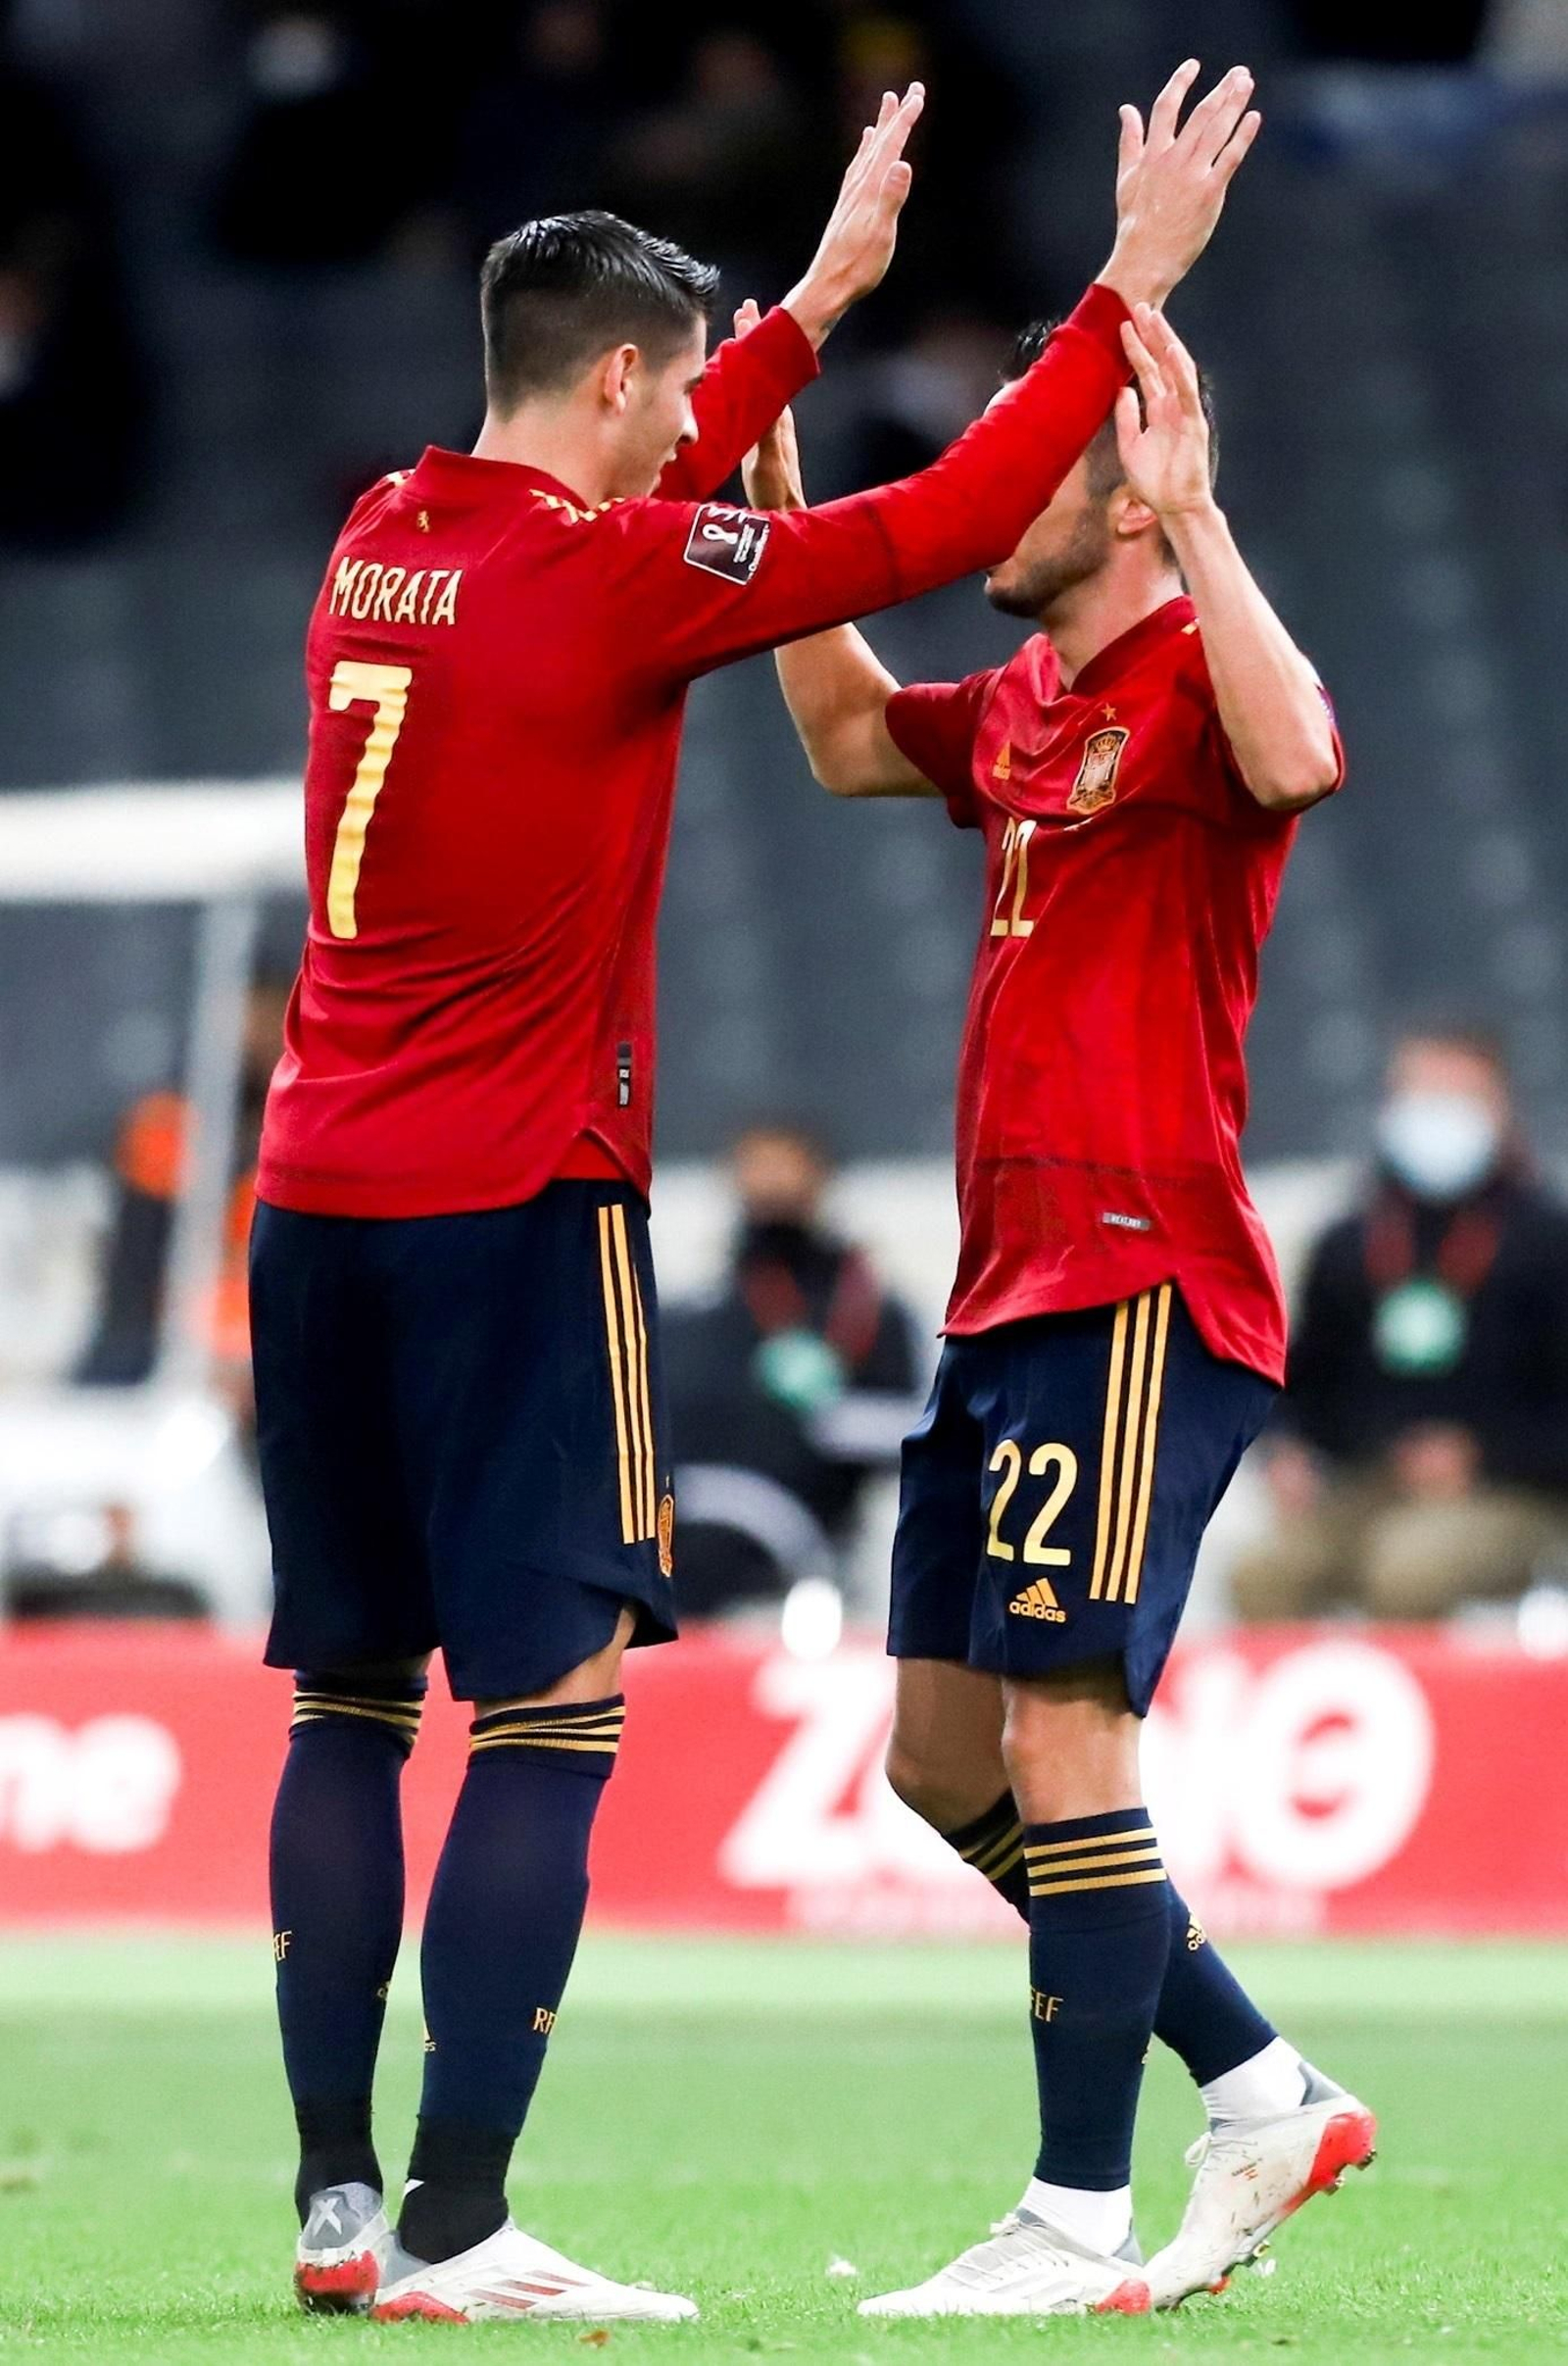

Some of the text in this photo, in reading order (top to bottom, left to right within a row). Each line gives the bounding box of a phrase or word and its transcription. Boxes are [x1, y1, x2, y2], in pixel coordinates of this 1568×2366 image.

[328, 556, 464, 625] MORATA
[326, 660, 413, 940] 7
[987, 1439, 1078, 1566] 22
[1008, 1601, 1066, 1623] adidas
